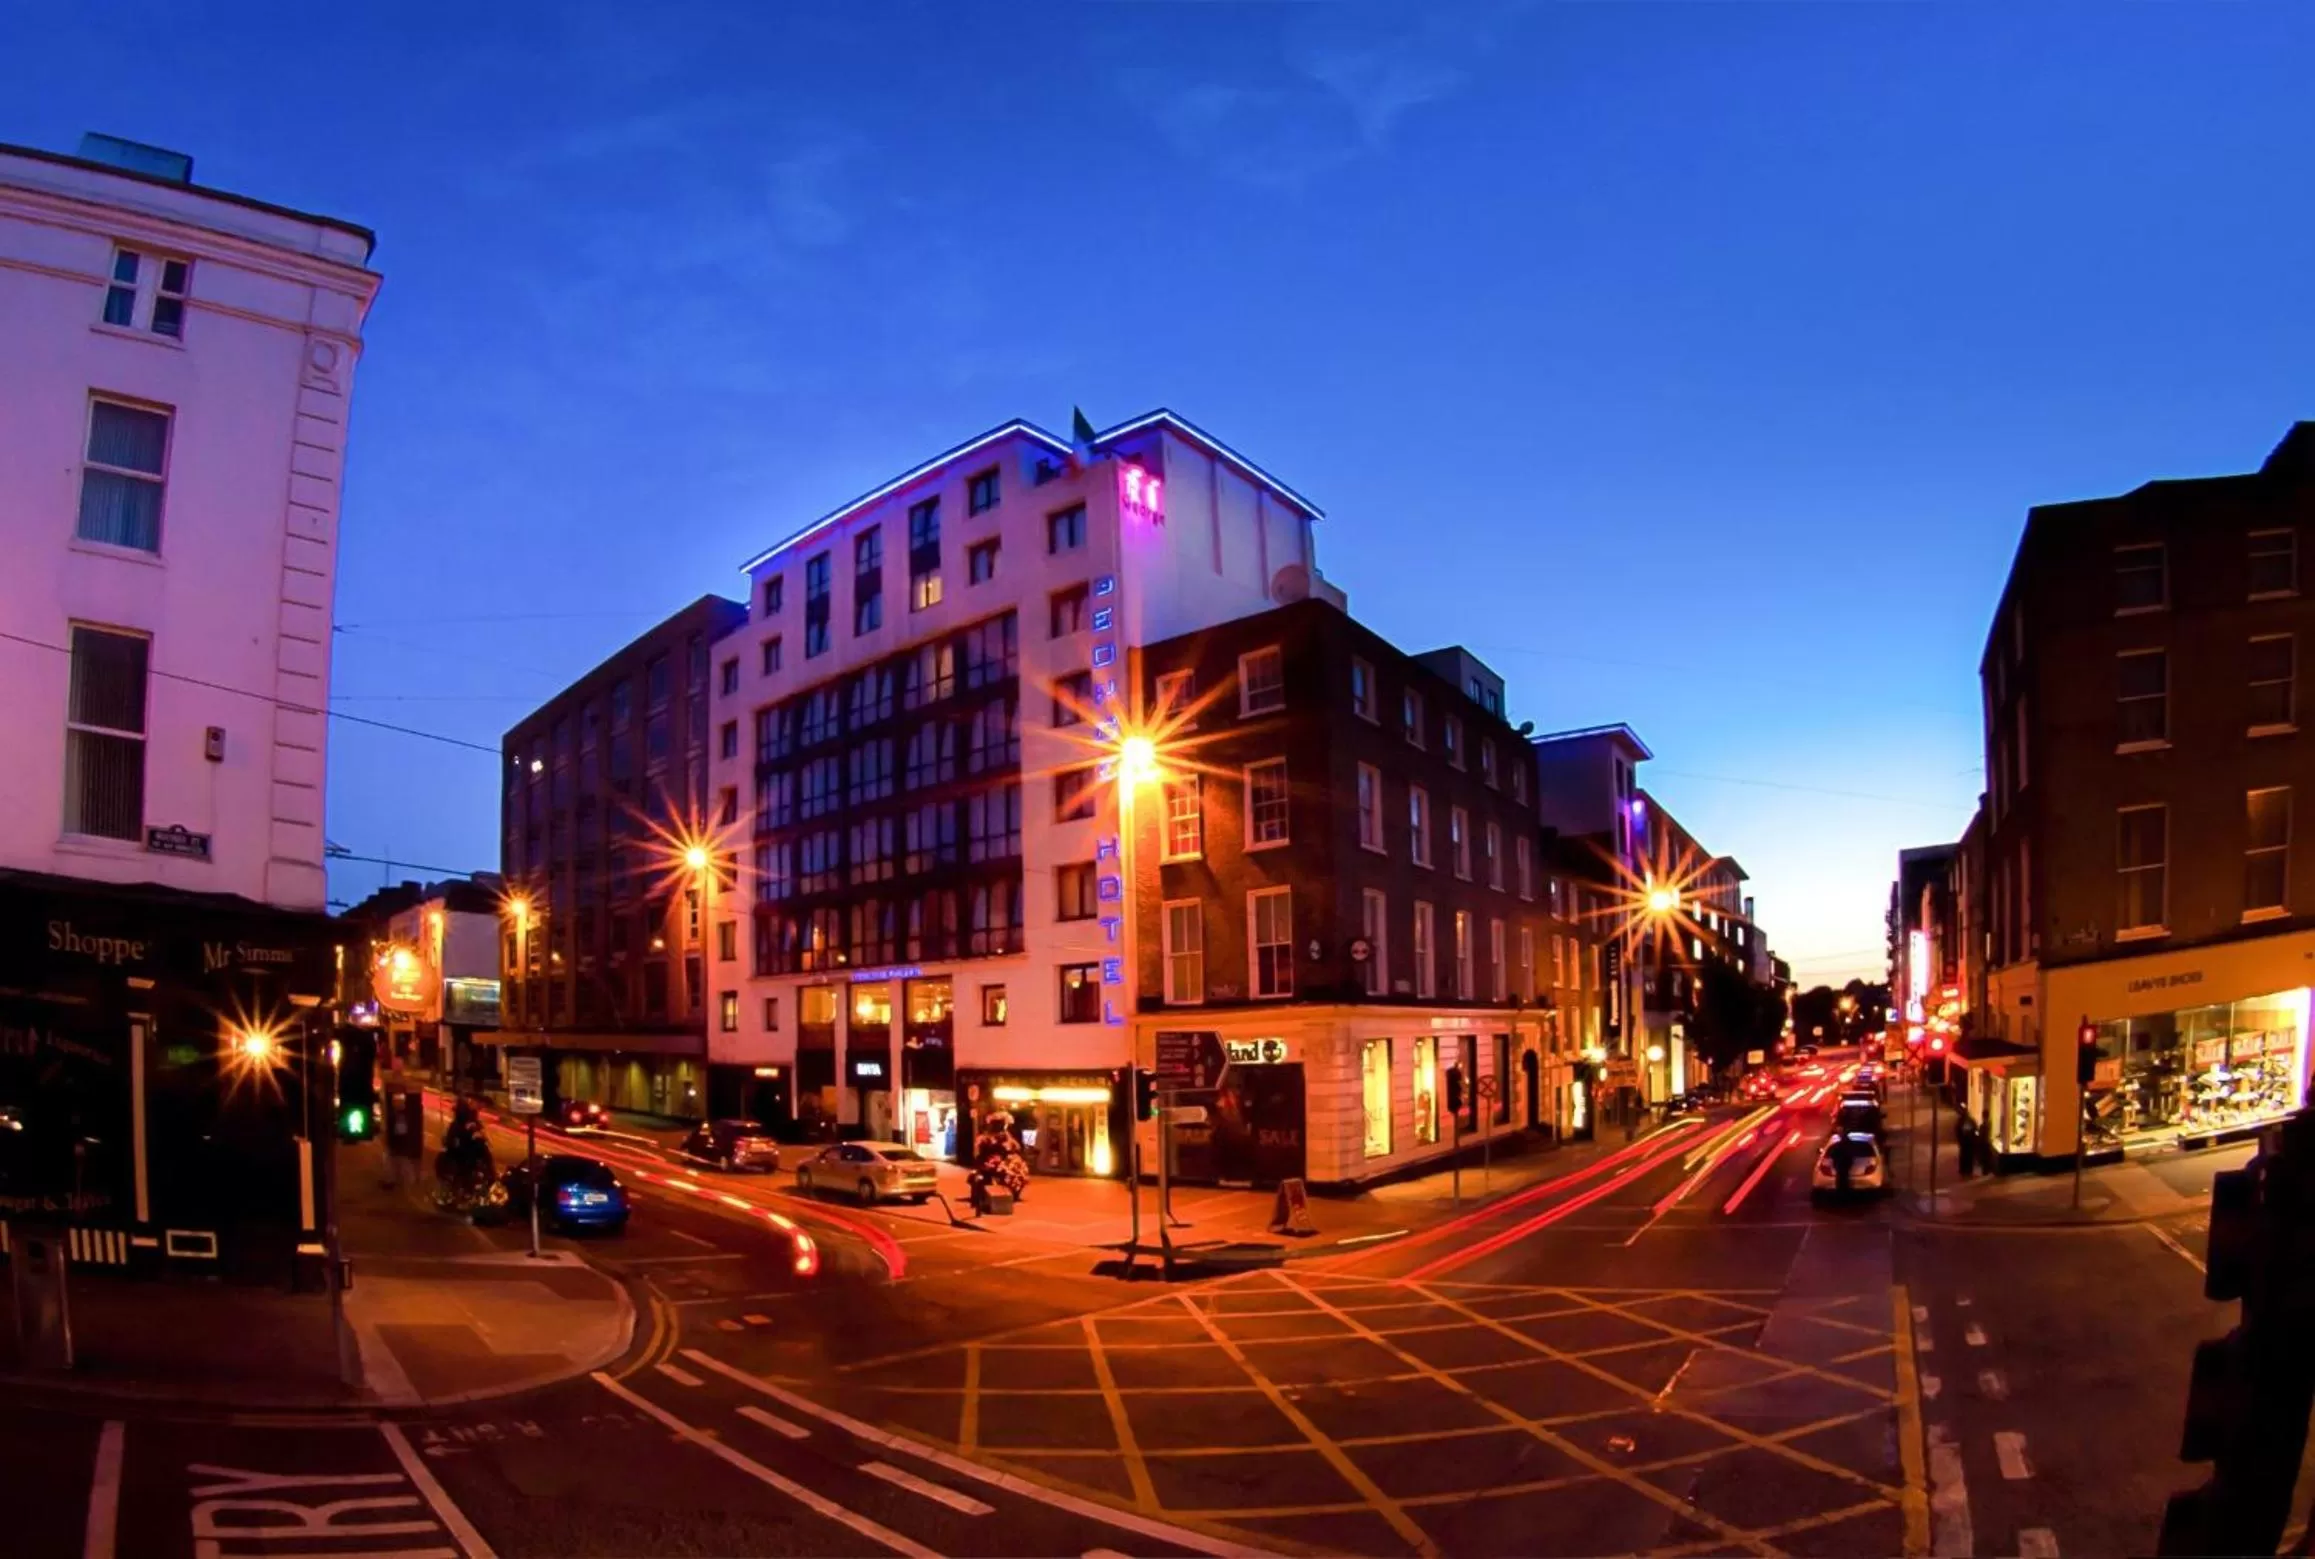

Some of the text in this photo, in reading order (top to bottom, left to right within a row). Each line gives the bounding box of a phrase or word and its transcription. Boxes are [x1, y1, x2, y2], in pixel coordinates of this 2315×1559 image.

[48, 919, 146, 966] Shoppe
[1096, 836, 1124, 1026] HOTEL
[203, 941, 232, 974] Mr
